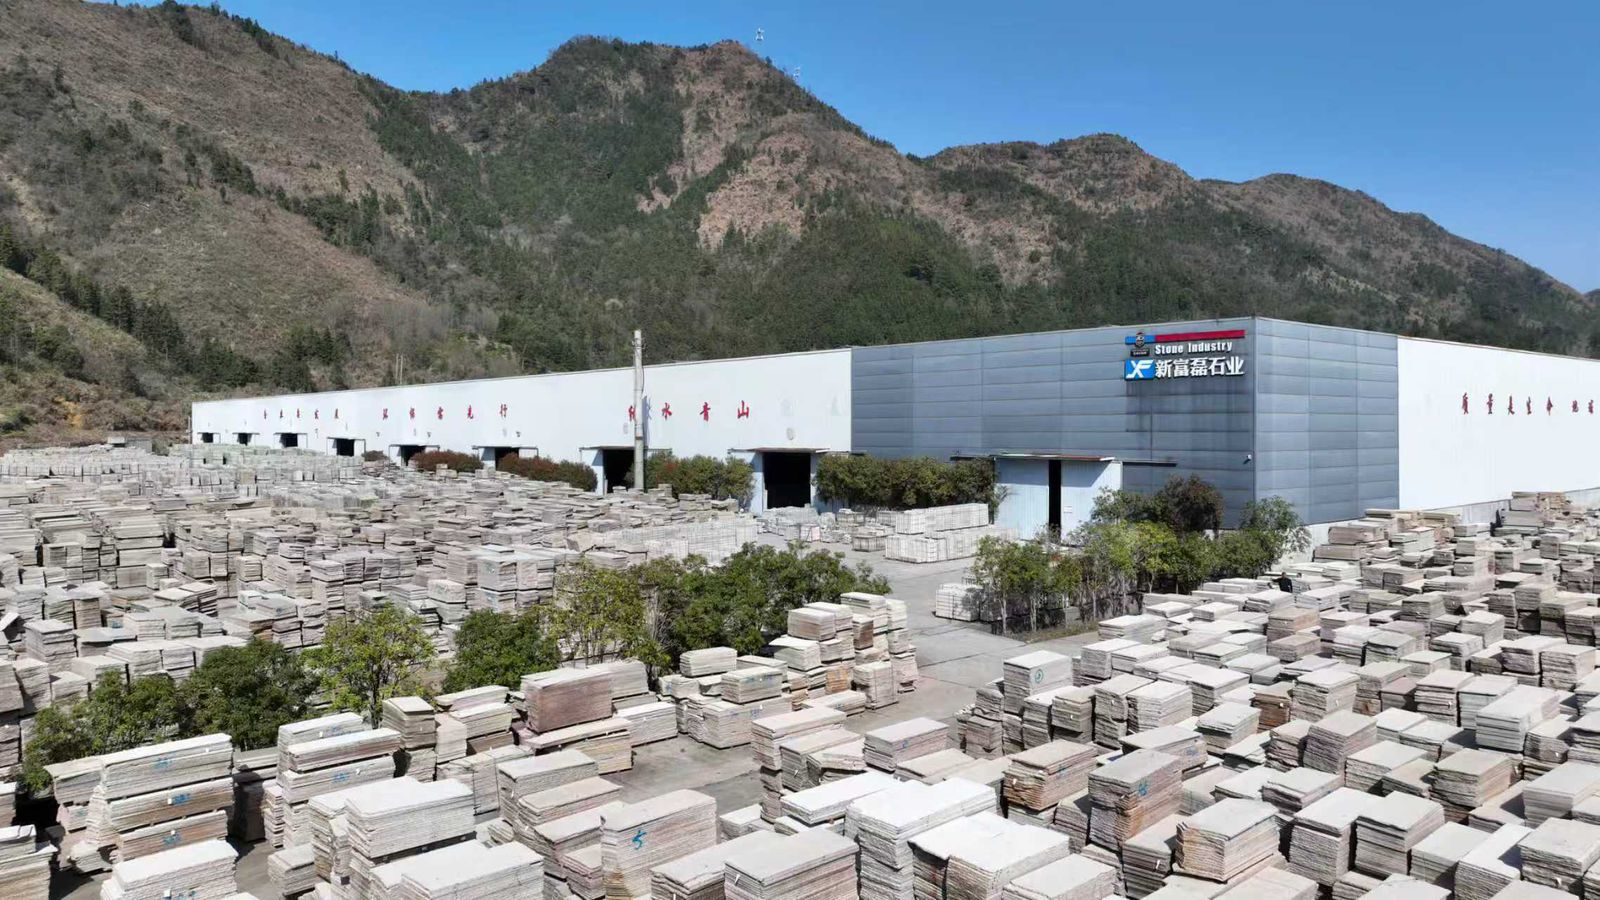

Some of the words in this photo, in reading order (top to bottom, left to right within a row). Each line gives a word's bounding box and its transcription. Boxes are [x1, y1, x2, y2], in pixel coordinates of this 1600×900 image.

[1155, 344, 1183, 355] Stone
[1188, 341, 1232, 353] Industry
[1126, 359, 1154, 379] XF
[1155, 356, 1244, 378] 新富磊石业
